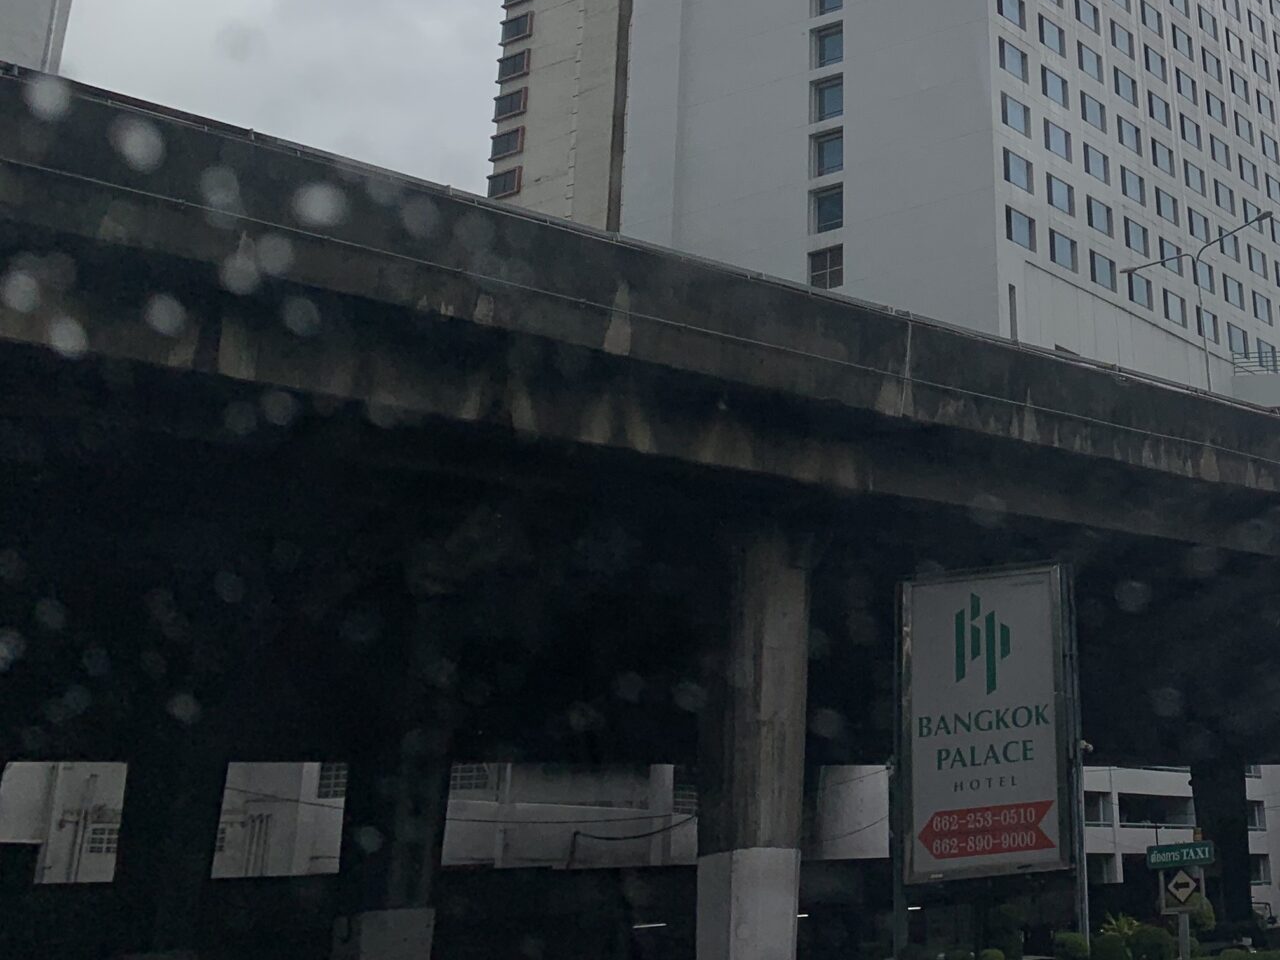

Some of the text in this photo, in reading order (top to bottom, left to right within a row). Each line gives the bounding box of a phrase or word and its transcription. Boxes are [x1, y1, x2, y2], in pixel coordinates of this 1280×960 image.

[918, 704, 1050, 738] BANGKOK
[937, 740, 1034, 771] PALACE
[954, 776, 1017, 792] HOTEL
[932, 807, 1035, 832] 662-253-0510
[932, 831, 1036, 855] 662-890-9000
[1181, 846, 1209, 860] TAXI
